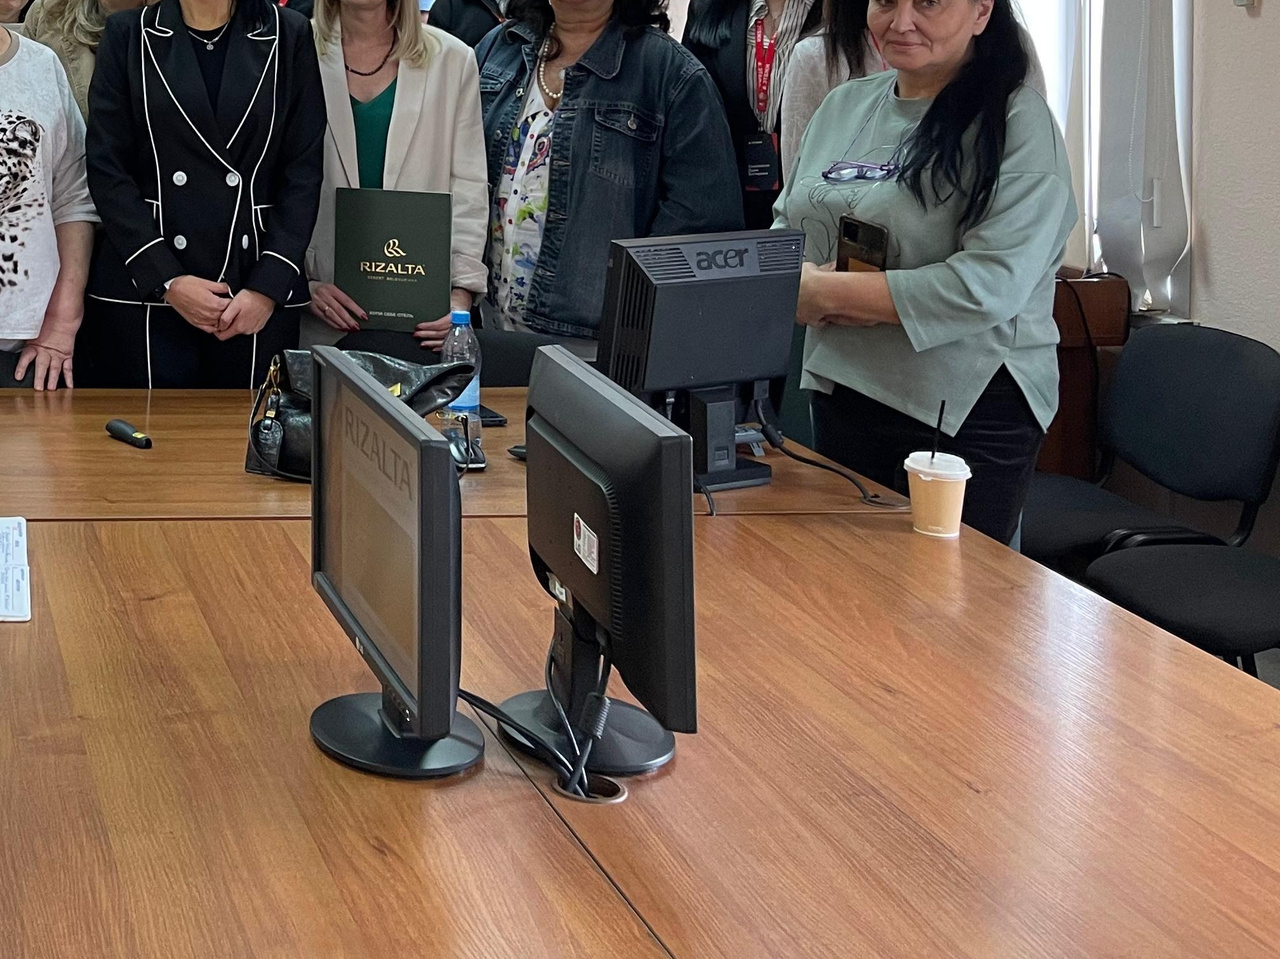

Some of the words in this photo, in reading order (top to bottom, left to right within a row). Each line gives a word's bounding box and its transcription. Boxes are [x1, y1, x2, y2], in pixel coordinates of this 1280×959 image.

[360, 261, 426, 276] RIZALTA
[695, 247, 749, 271] acer
[344, 407, 413, 501] RIZALTA
